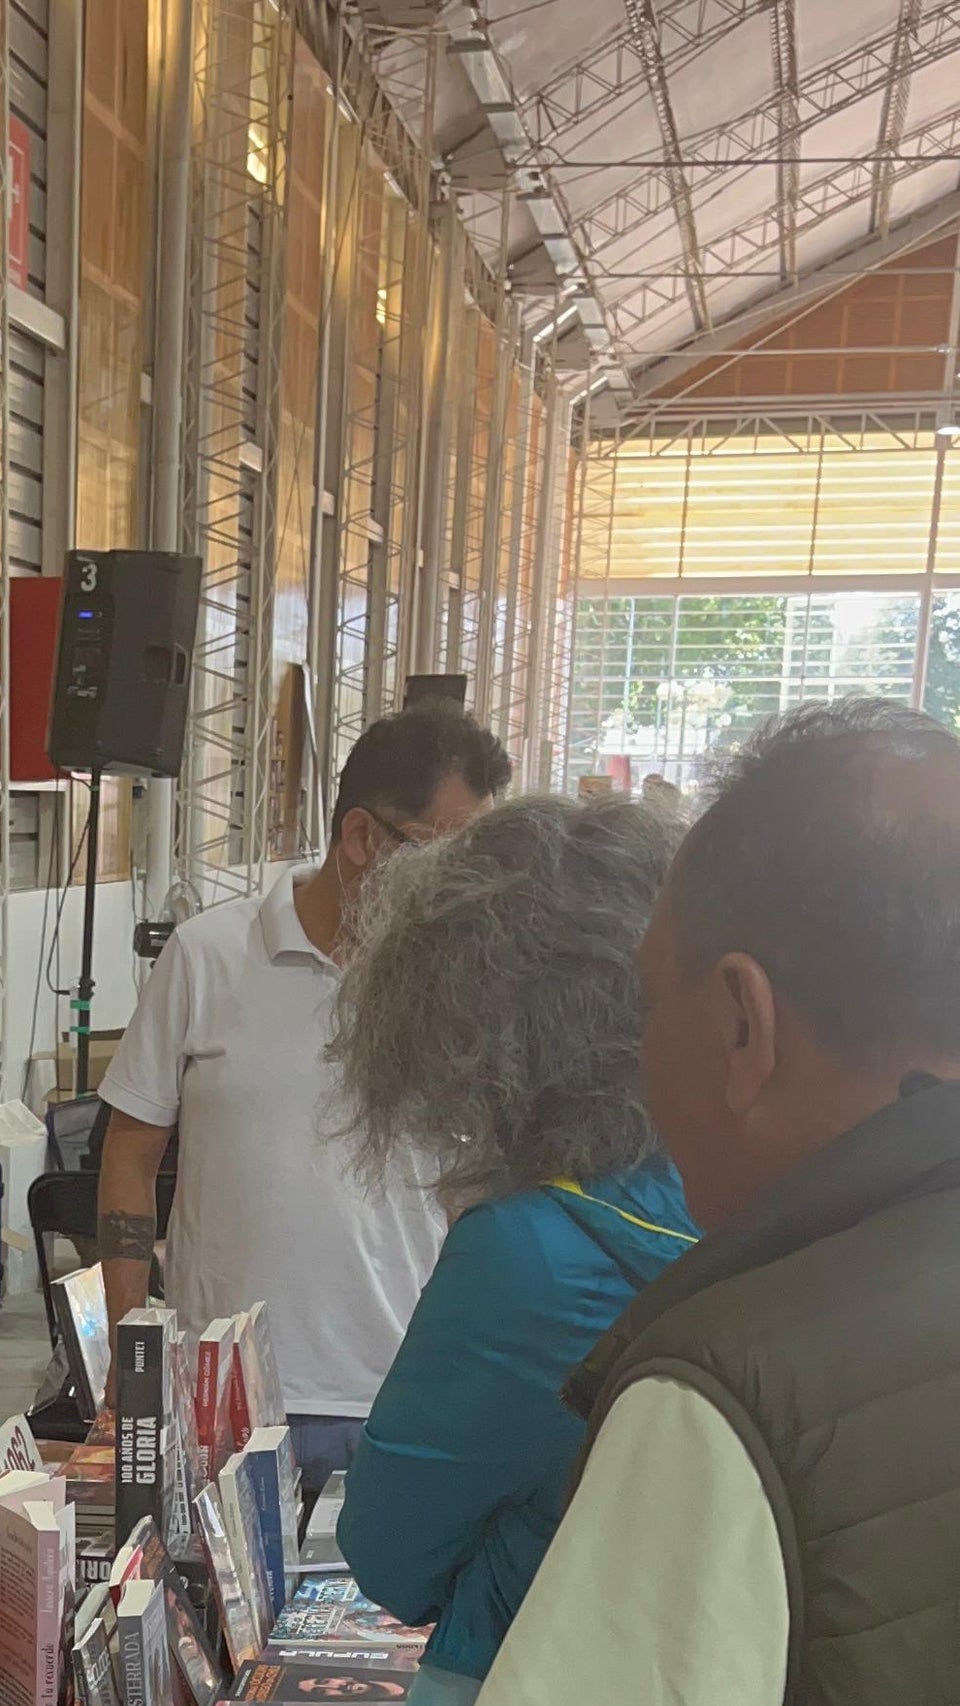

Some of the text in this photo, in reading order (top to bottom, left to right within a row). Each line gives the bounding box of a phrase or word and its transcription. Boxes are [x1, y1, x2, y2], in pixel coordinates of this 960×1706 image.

[81, 563, 98, 592] 3
[121, 1416, 134, 1483] 100 AÑOS DE
[136, 1416, 157, 1485] GLORIA
